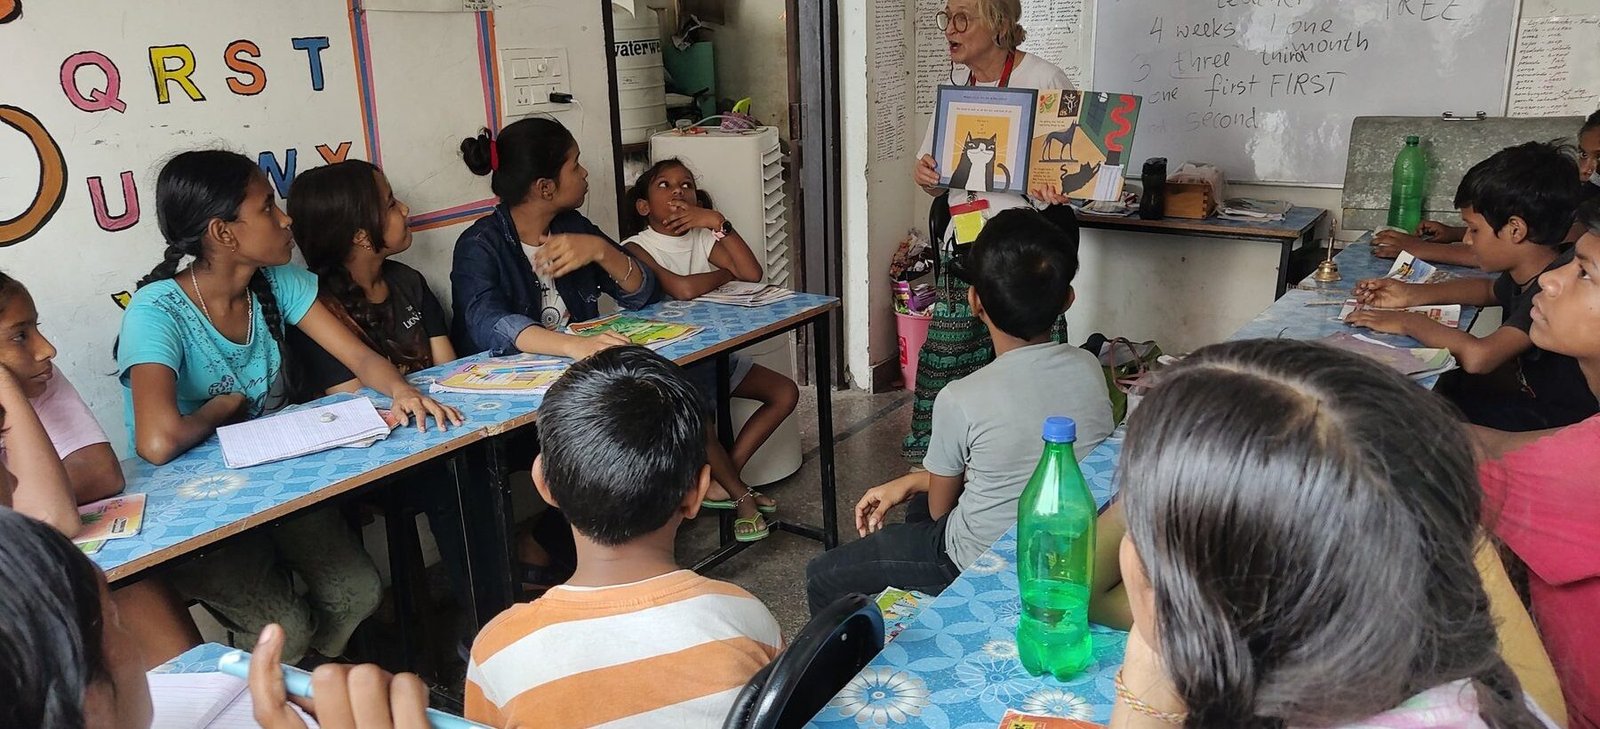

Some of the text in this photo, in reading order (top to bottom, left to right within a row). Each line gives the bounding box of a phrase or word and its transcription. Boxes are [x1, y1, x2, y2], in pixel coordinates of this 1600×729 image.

[1149, 16, 1163, 43] 4
[1176, 17, 1236, 39] weeks
[1286, 18, 1333, 34] one
[1291, 31, 1369, 53] month
[1174, 50, 1230, 73] three
[1261, 46, 1308, 66] third
[60, 36, 330, 114] Q R S T
[1148, 71, 1347, 107] one first FIRST
[1185, 107, 1259, 130] second
[86, 170, 141, 232] U
